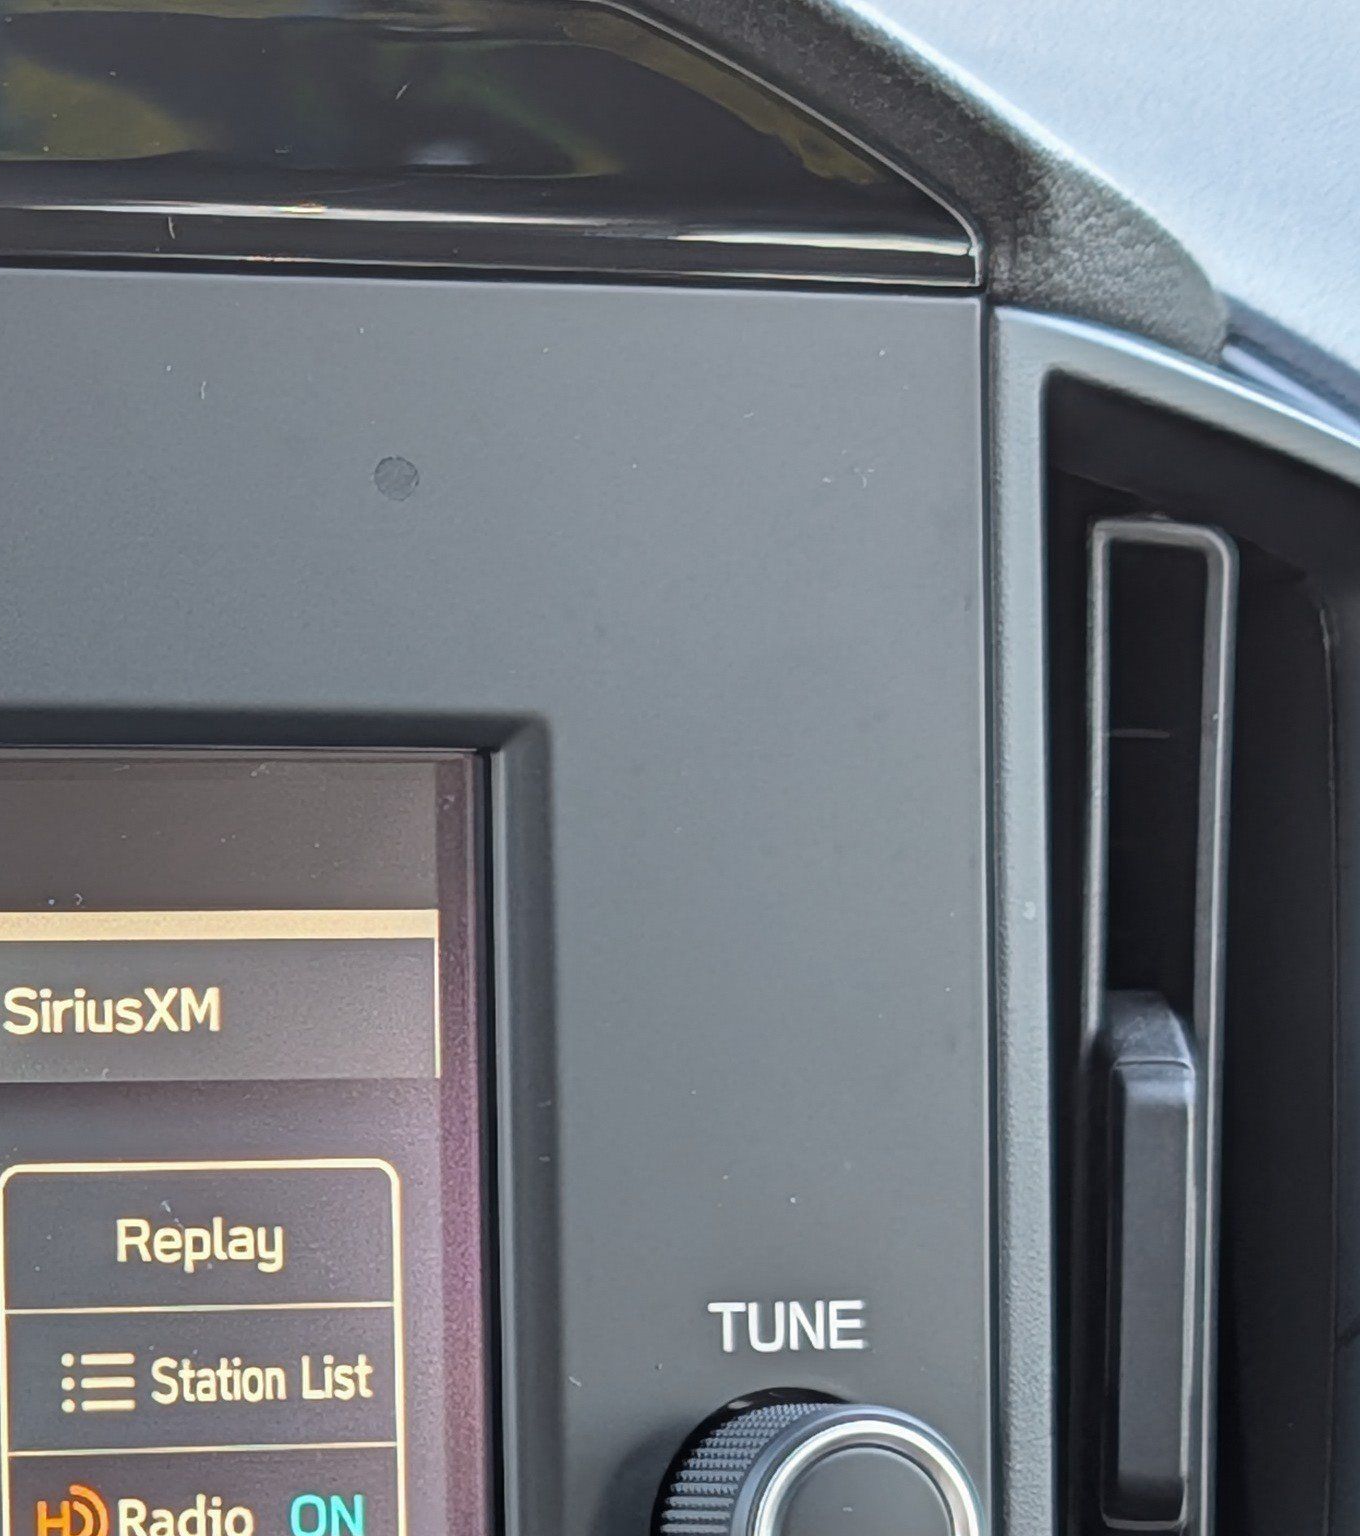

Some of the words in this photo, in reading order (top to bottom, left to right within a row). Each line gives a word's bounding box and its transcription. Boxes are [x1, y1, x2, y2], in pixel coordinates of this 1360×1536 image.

[3, 987, 220, 1034] SiriusXM
[117, 1217, 283, 1273] Replay
[708, 1300, 866, 1352] TUNE
[152, 1357, 287, 1404] Station
[302, 1354, 373, 1400] List
